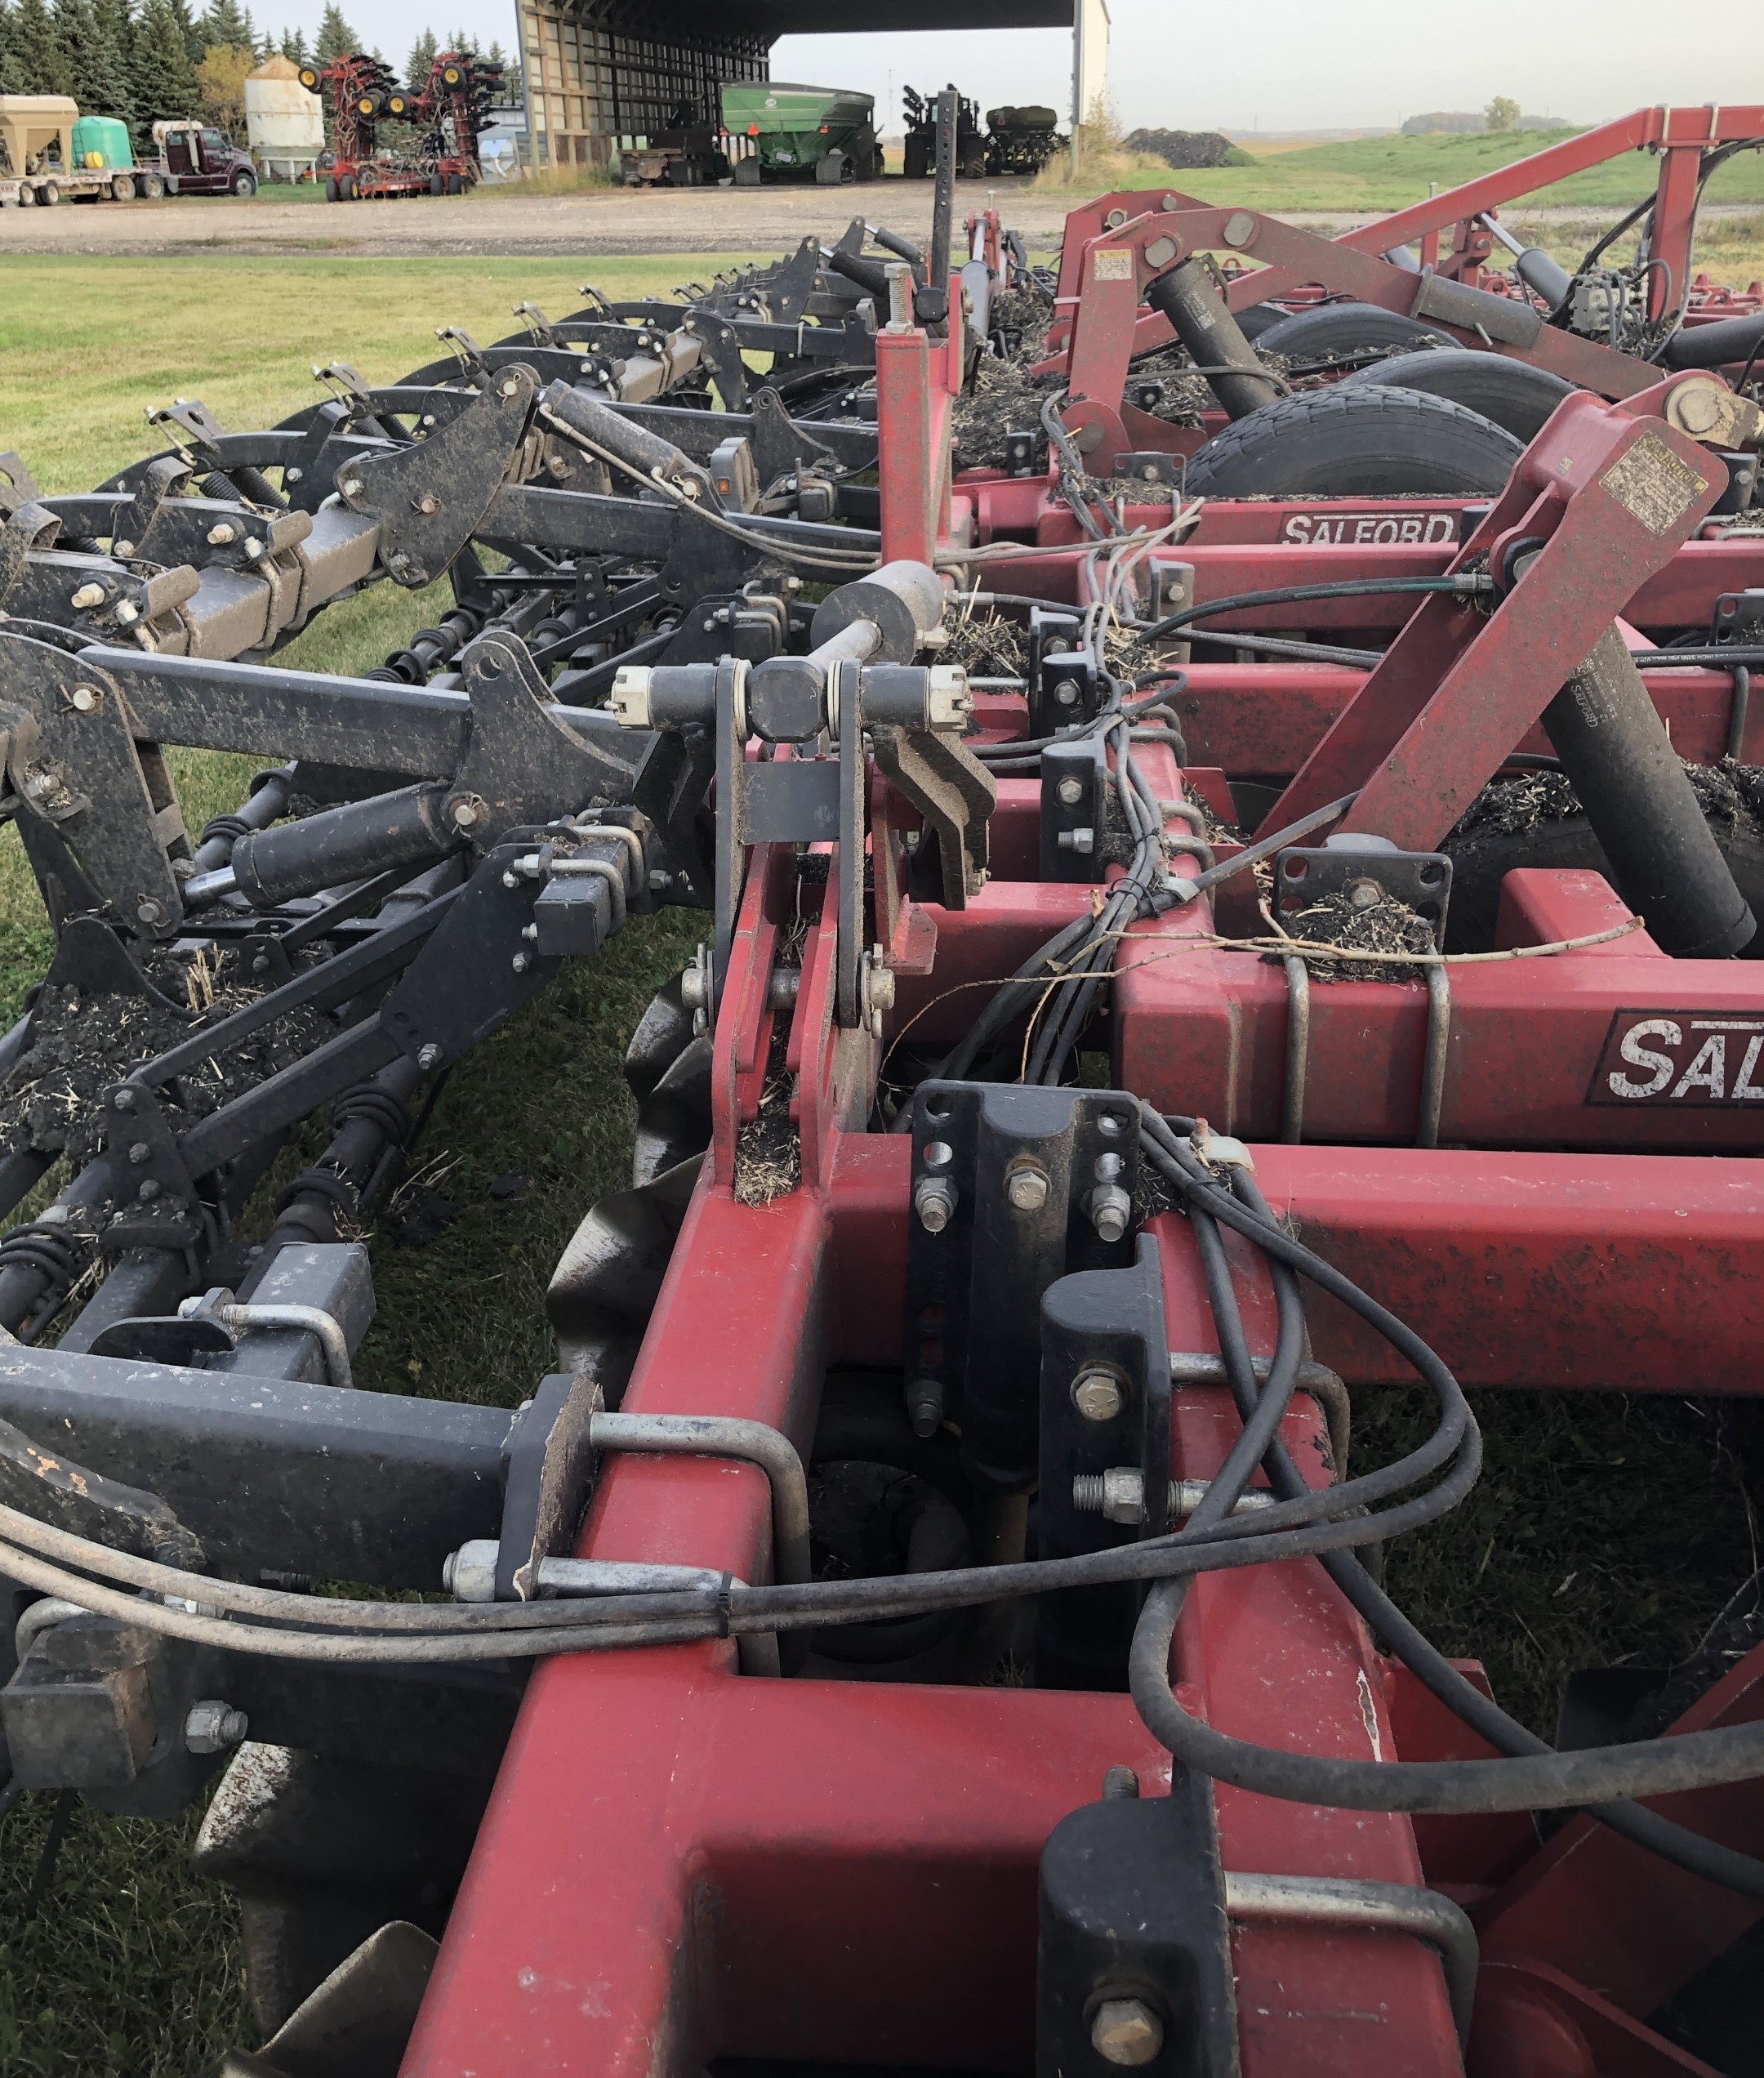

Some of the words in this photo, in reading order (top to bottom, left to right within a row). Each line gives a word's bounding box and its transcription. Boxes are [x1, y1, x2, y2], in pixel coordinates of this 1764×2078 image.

[1282, 514, 1454, 544] SALFORD
[1570, 684, 1598, 728] SALFORD
[1609, 1019, 1764, 1099] SAL
